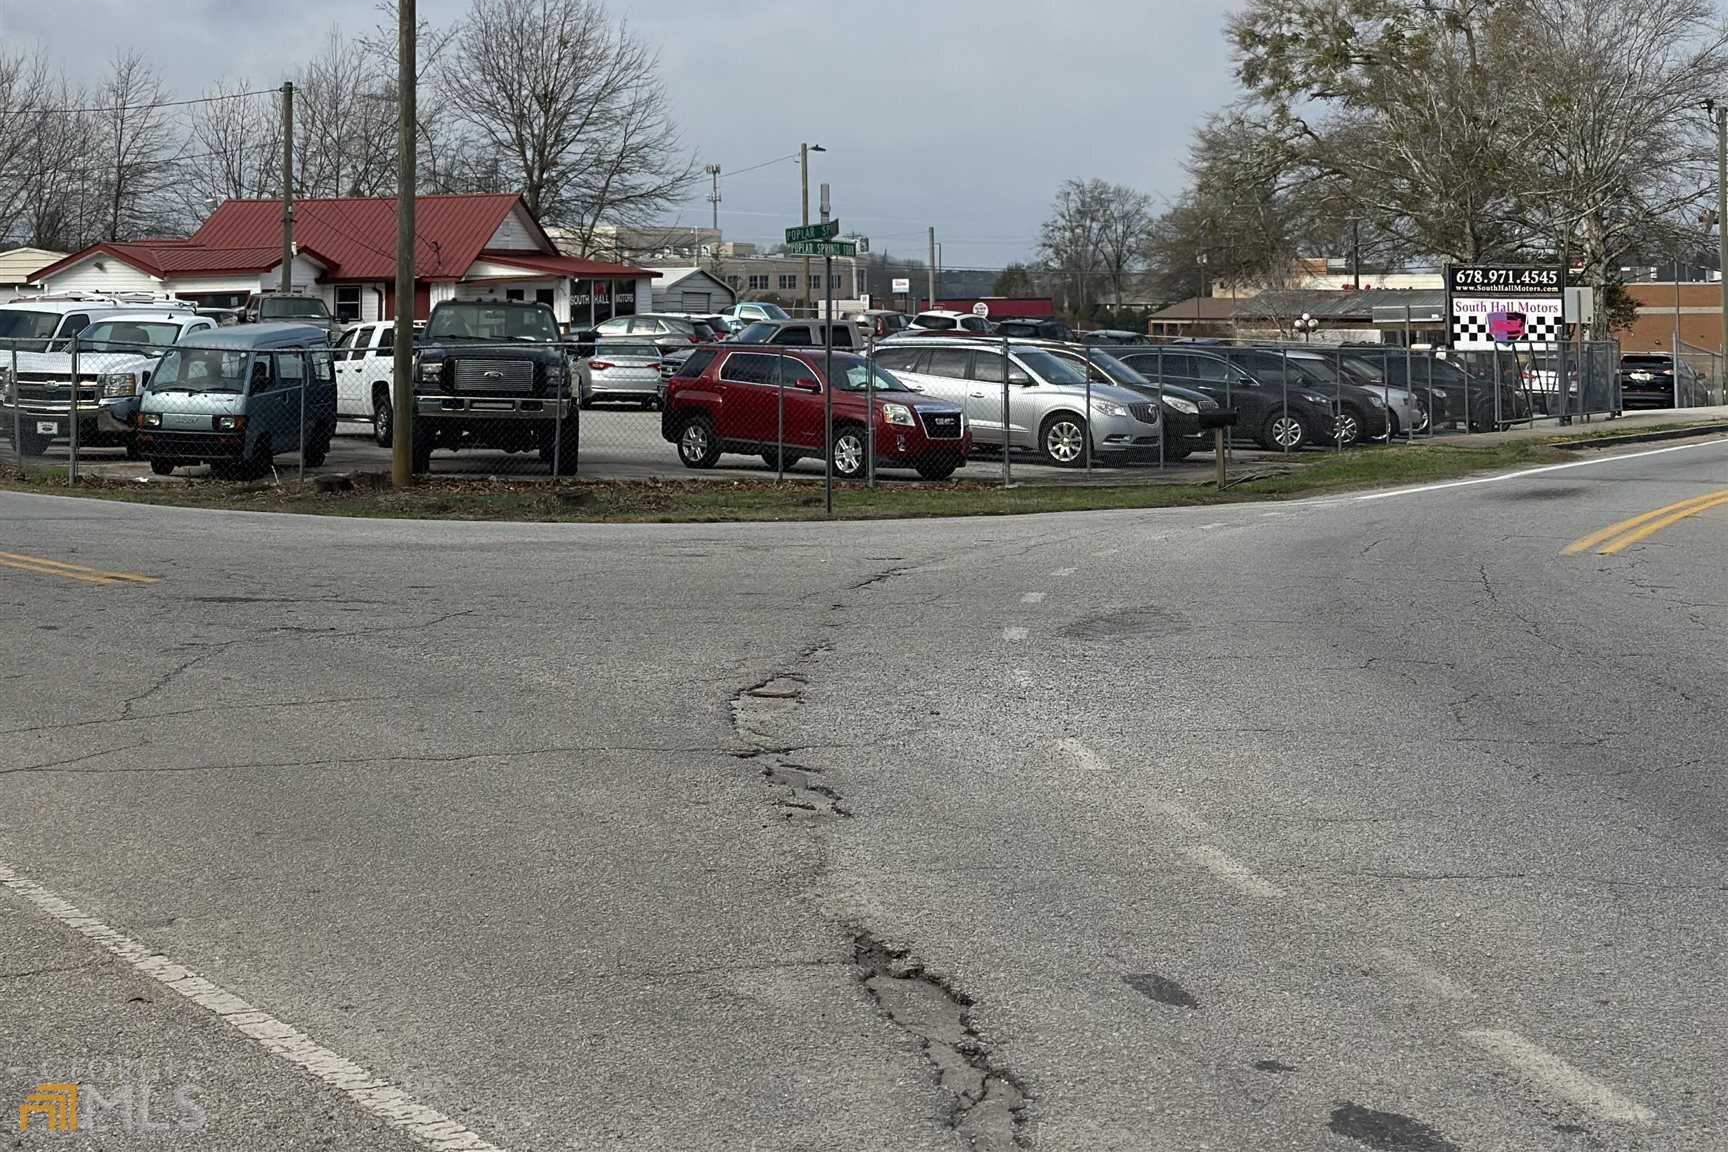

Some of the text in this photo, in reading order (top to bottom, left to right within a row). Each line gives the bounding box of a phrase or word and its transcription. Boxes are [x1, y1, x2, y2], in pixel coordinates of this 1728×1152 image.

[786, 227, 815, 242] POPLAR
[791, 243, 813, 254] POPLAR
[1456, 269, 1558, 284] 678.971.4545
[570, 293, 634, 305] SOUTH HALL MOTORS
[1455, 301, 1559, 313] South Hall Motors
